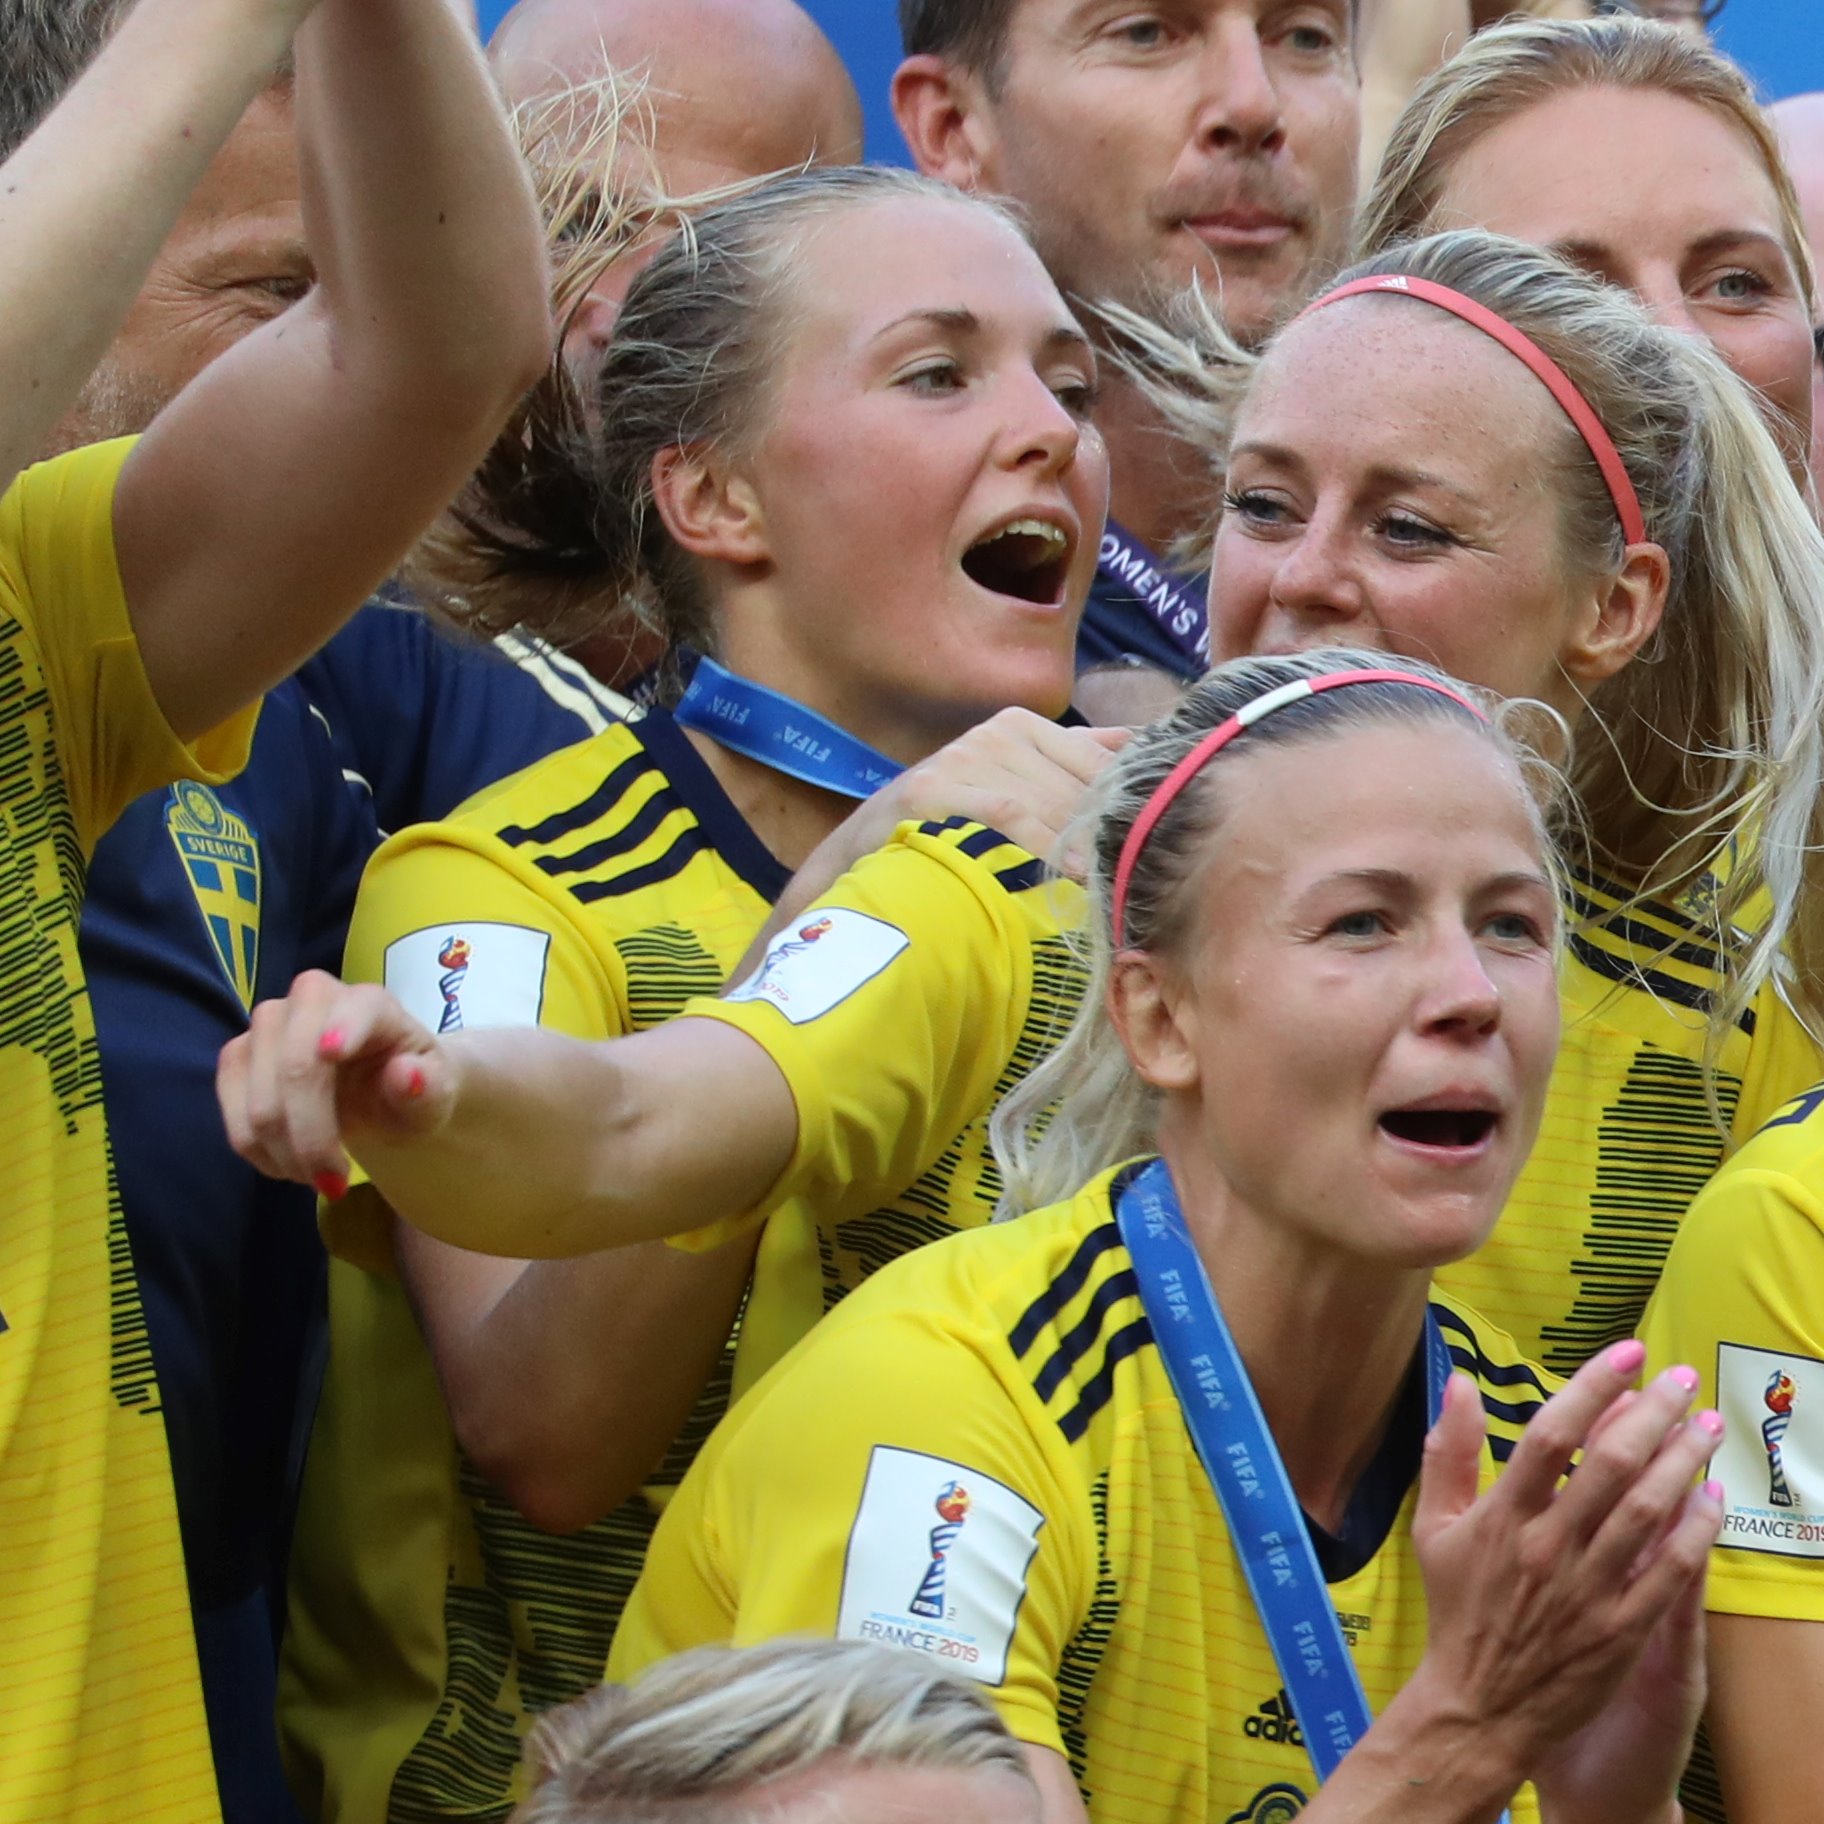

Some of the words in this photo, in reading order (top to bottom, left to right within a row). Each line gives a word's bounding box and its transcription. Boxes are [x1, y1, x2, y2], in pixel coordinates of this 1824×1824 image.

[1099, 536, 1197, 636] OMEN'S
[710, 696, 750, 725] FIFA
[782, 726, 832, 762] FIFA
[188, 836, 248, 862] SVERIGE
[1159, 1269, 1189, 1321] FIFA
[1189, 1355, 1224, 1409] FIFA
[1226, 1442, 1260, 1497] FIFA
[1260, 1531, 1290, 1587] FIFA
[1293, 1620, 1324, 1677] FIFA
[1723, 1515, 1793, 1540] FRANCE
[860, 1620, 936, 1651] FRANCE
[937, 1639, 979, 1662] 2019
